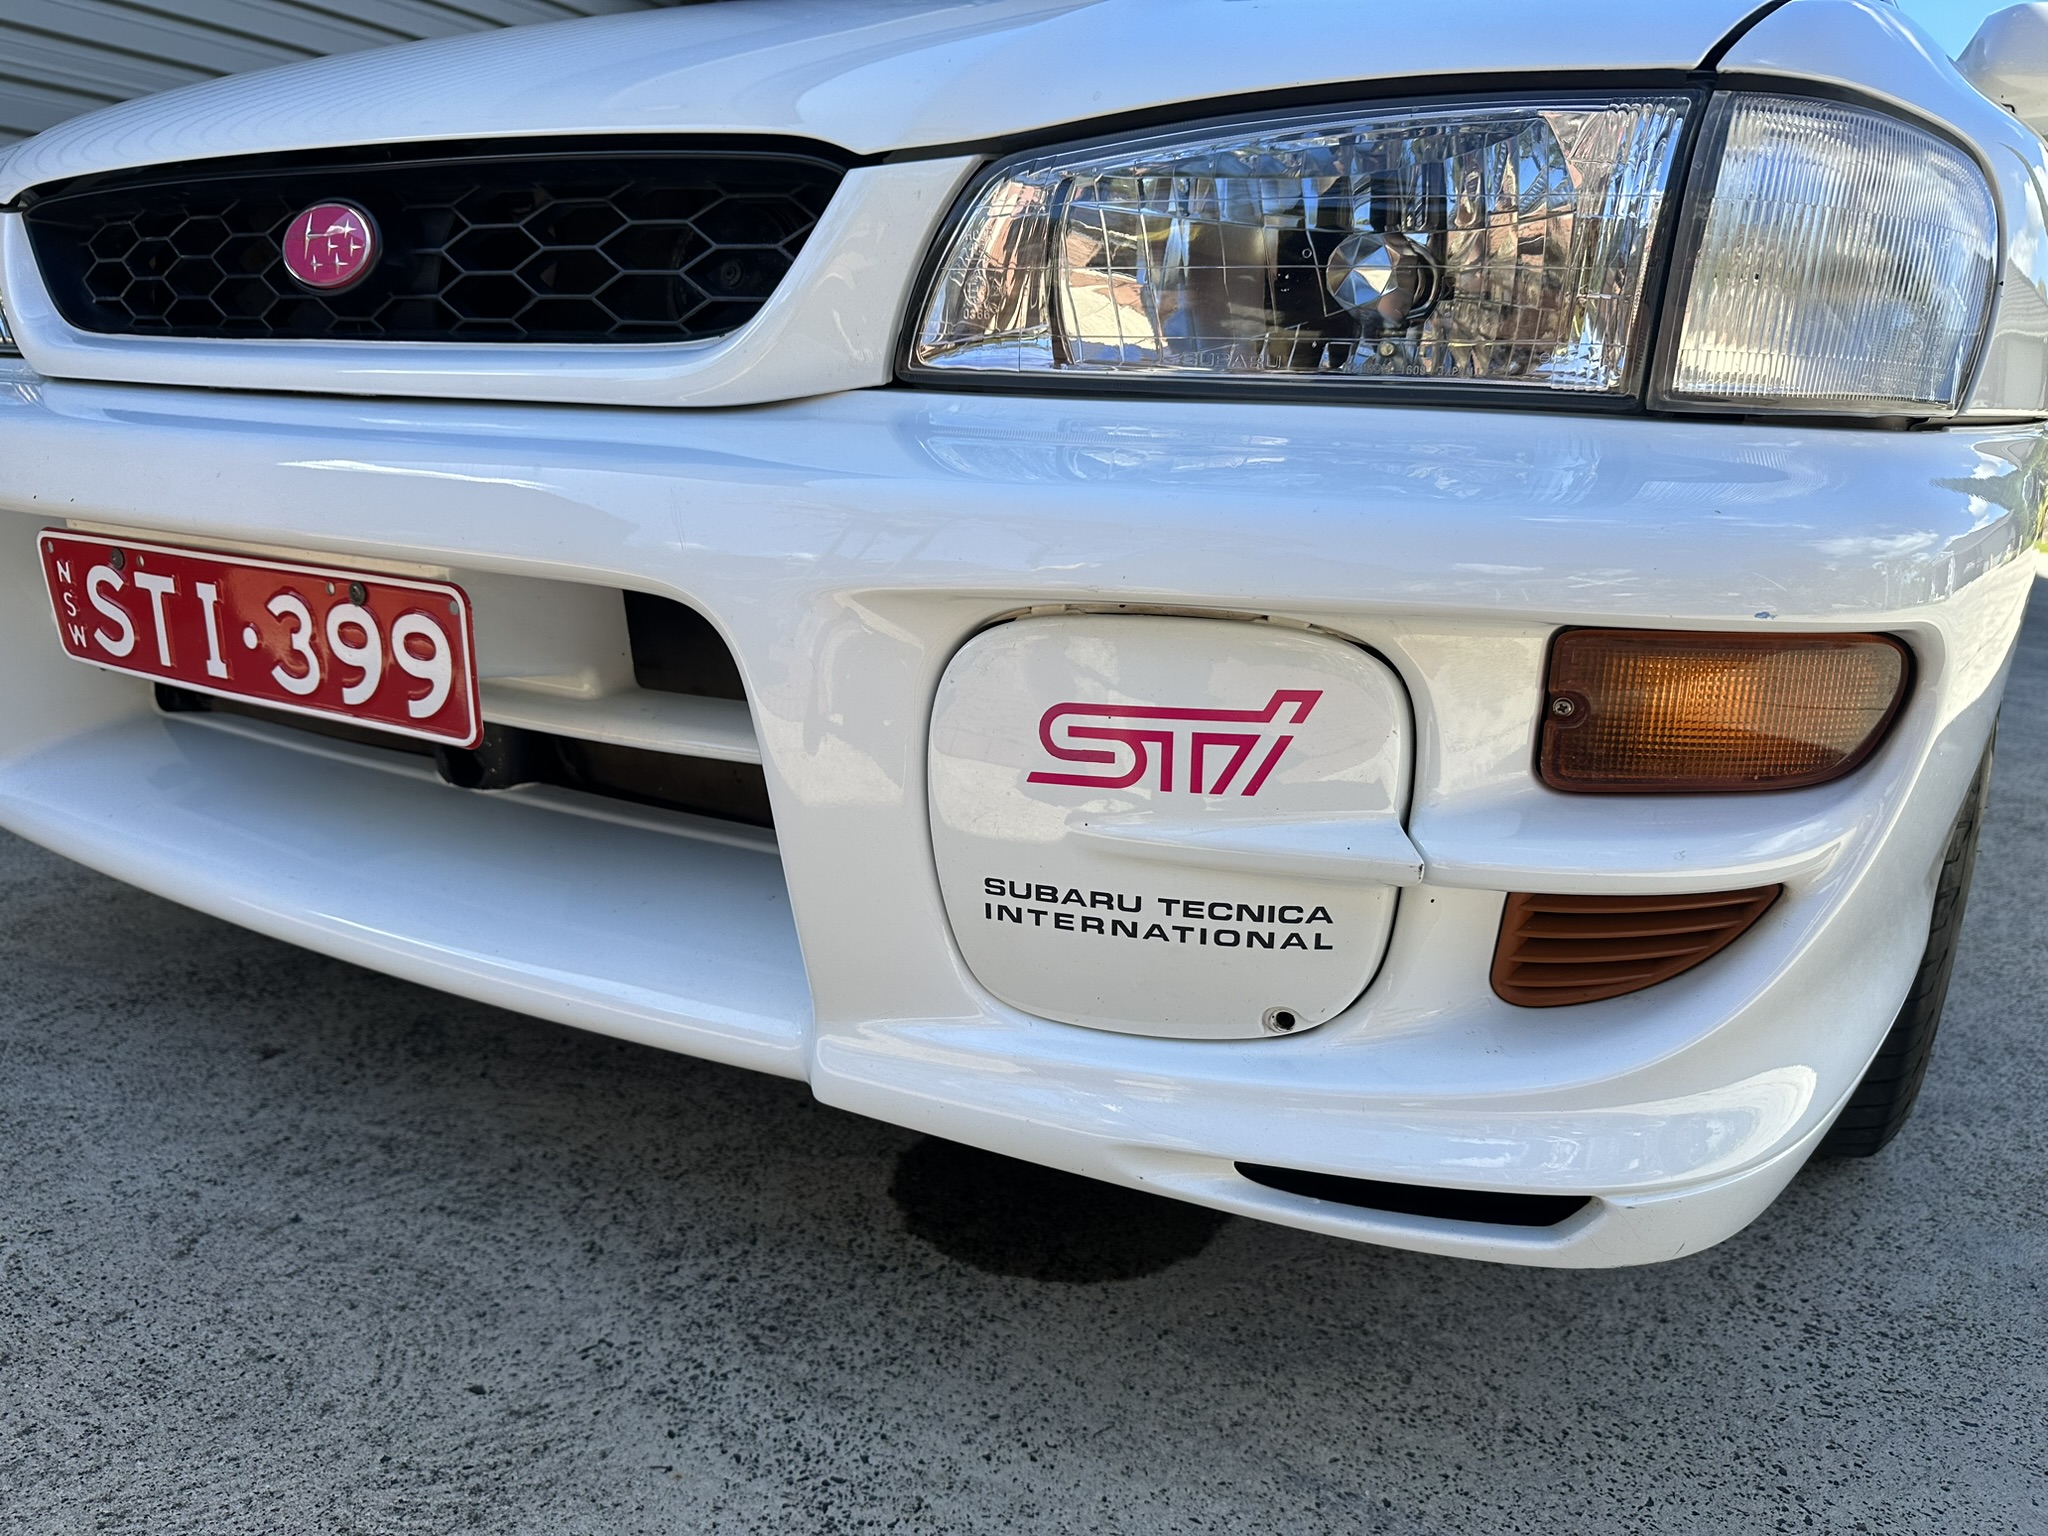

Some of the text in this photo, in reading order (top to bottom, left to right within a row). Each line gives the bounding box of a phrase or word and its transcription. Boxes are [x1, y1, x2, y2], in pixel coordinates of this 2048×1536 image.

[984, 877, 1333, 925] SUBARU TECNICA
[985, 903, 1333, 951] INTERNATIONAL
